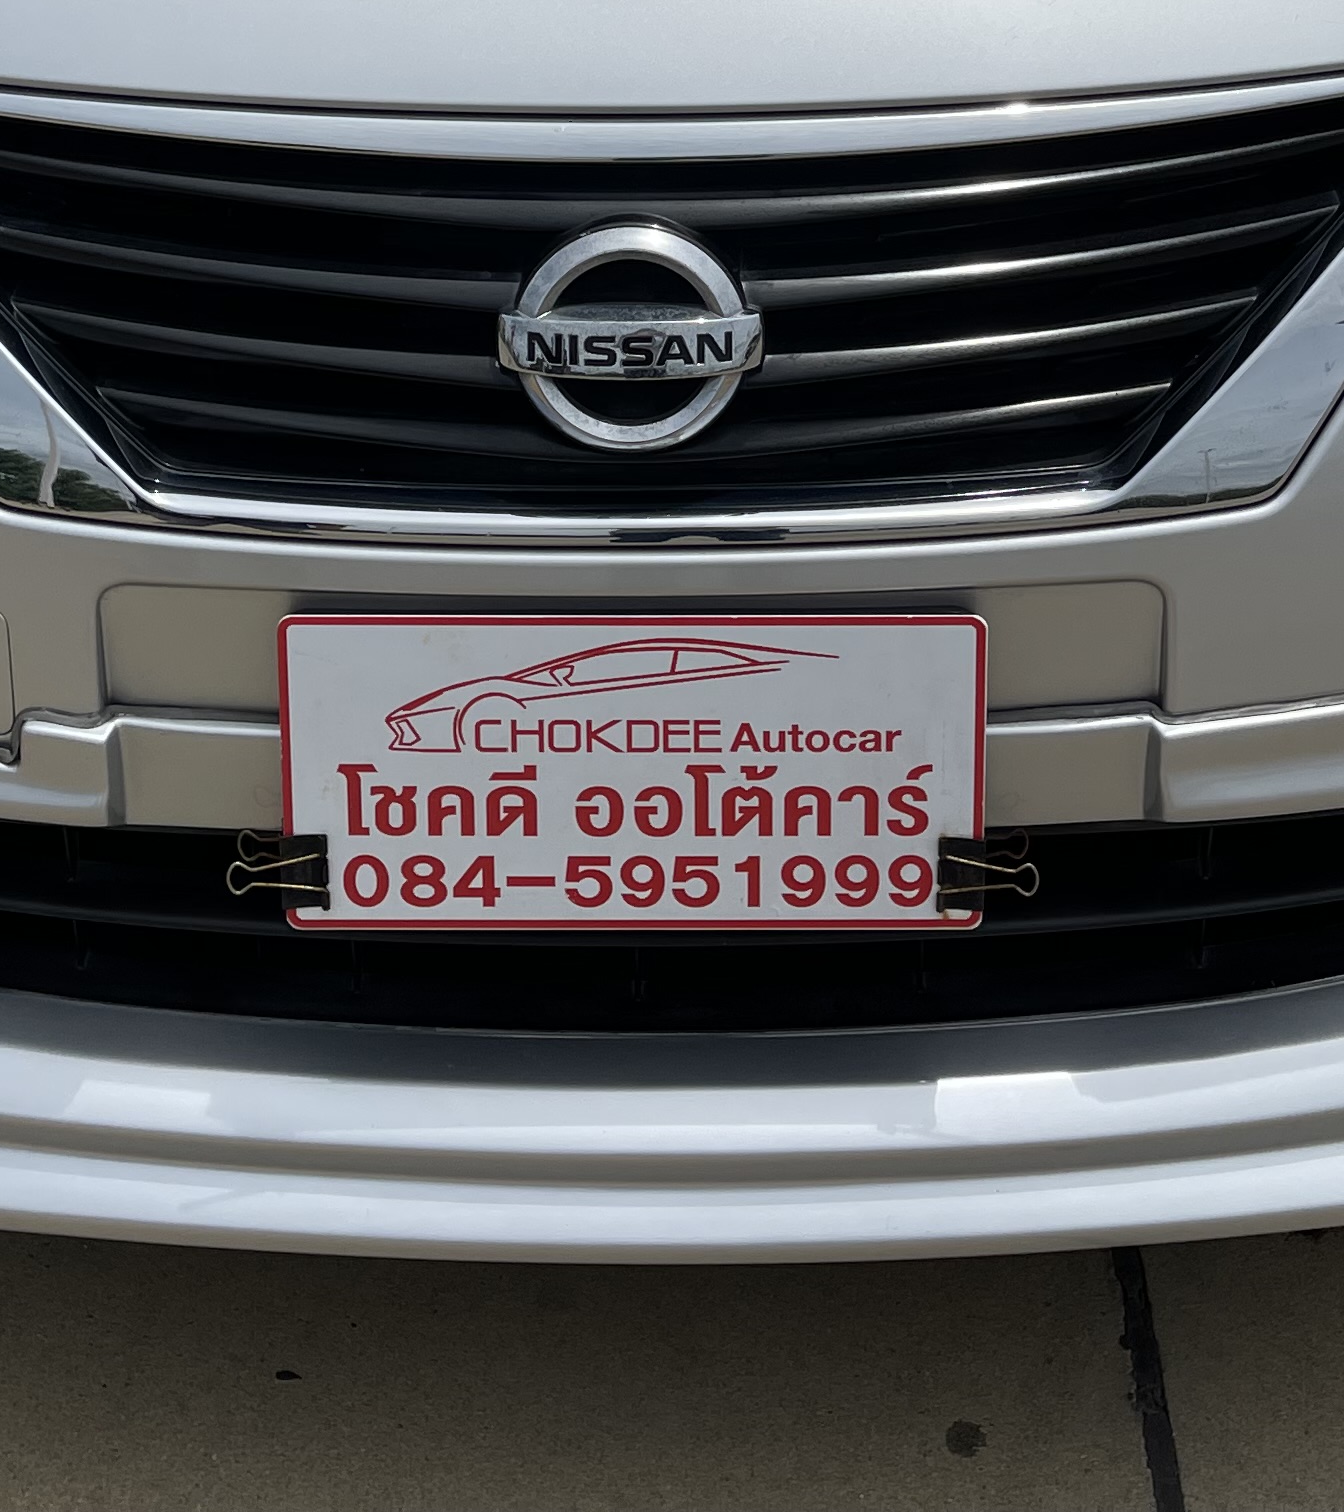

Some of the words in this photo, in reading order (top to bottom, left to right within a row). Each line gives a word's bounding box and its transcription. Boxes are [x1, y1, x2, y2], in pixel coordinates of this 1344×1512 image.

[526, 330, 734, 368] NISSAN
[474, 718, 723, 754] CHOKDEE
[729, 722, 902, 754] Autocar
[336, 763, 540, 837] โชคดี
[574, 763, 934, 837] ออโต้คาร์
[342, 854, 934, 908] 084-5951999
